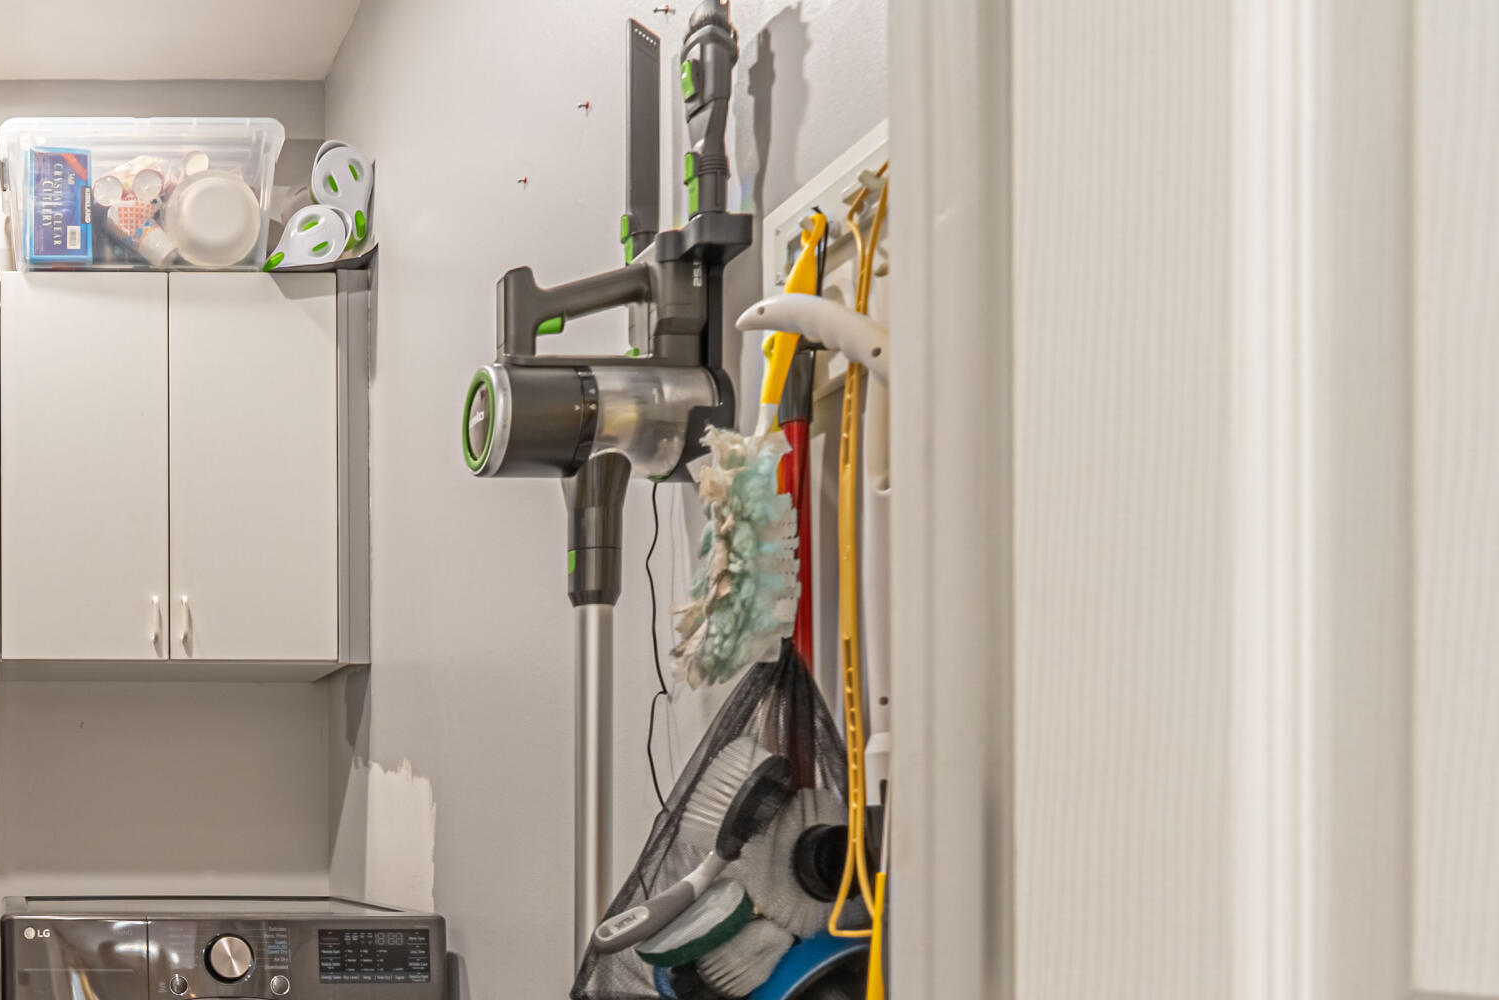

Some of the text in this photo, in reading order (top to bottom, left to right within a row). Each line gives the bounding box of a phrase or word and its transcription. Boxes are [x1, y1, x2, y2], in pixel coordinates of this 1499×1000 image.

[42, 180, 54, 227] CUTLERY
[53, 163, 63, 246] CRYSTAL CLEAR
[37, 928, 51, 938] LG
